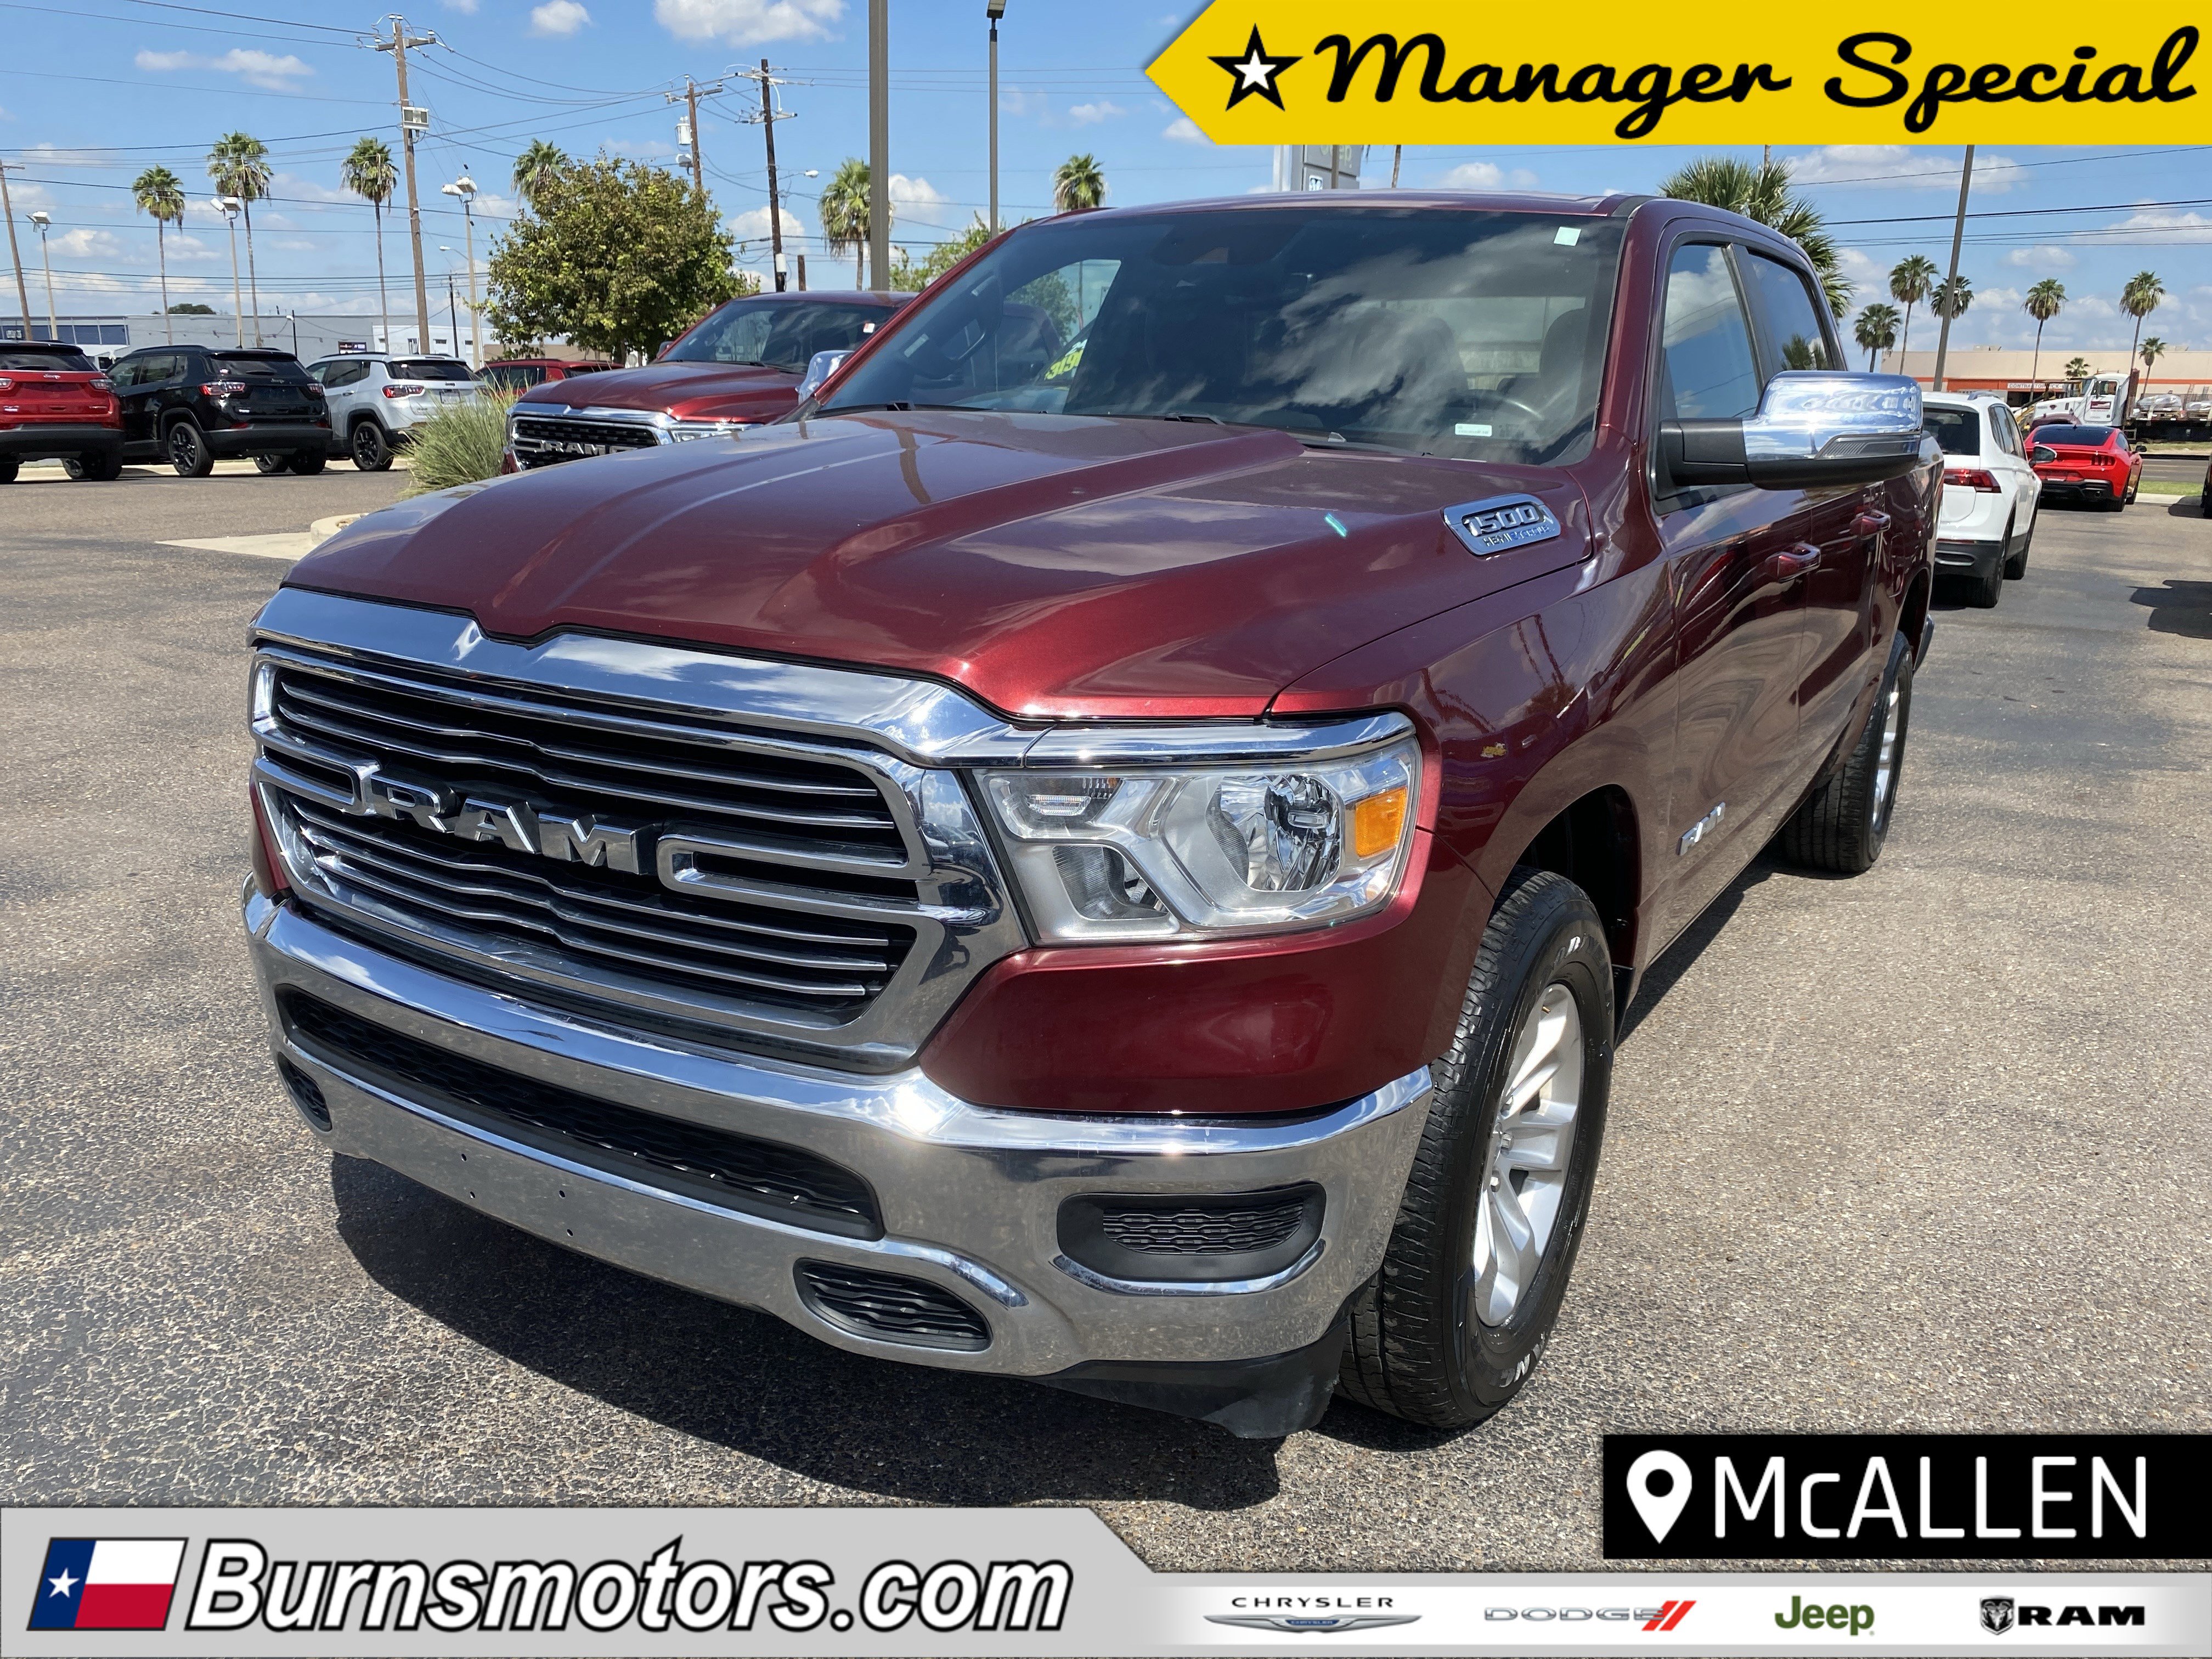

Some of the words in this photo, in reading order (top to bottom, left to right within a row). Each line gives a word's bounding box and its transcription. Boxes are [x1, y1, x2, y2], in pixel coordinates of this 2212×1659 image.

[548, 441, 606, 456] RAM
[1464, 504, 1539, 537] 1500
[368, 770, 658, 876] RAM
[1676, 802, 1726, 856] RAM
